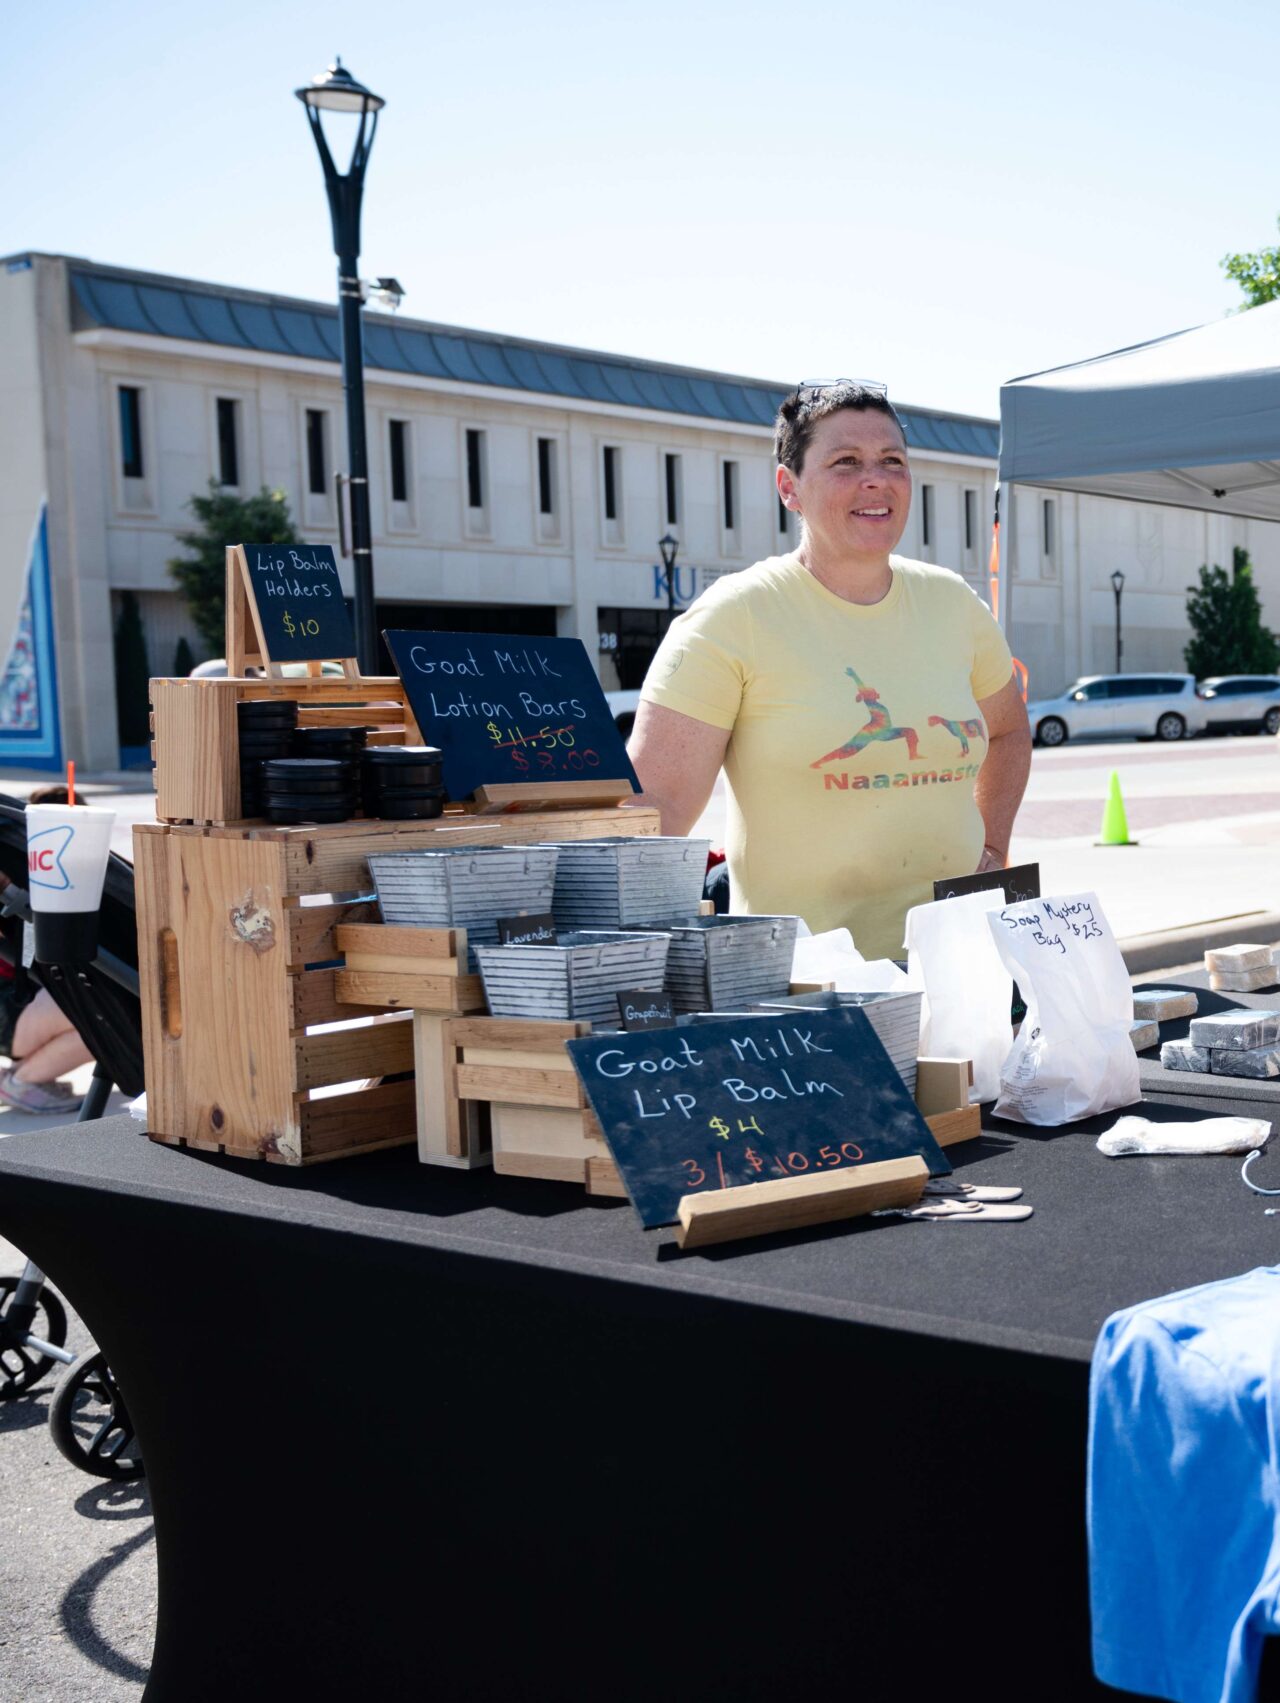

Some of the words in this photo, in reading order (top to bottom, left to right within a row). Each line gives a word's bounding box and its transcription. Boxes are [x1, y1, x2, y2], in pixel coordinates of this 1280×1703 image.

[257, 552, 285, 577] Lip
[288, 550, 336, 575] Balm
[265, 578, 332, 597] Holders
[653, 565, 697, 605] KU
[282, 610, 320, 638] $10
[410, 646, 485, 676] Goat
[494, 649, 562, 678] Milk
[430, 691, 514, 720] Lotion
[519, 691, 587, 719] Bars
[486, 721, 576, 748] $11.50
[1000, 911, 1044, 932] Soap
[1043, 902, 1094, 930] Mystery
[506, 926, 557, 945] Lavender
[1032, 931, 1066, 954] Bag
[1072, 922, 1103, 940] $25
[625, 1001, 673, 1024] Grapefruit
[596, 1038, 703, 1078] Goat
[730, 1028, 833, 1061] Milk
[634, 1089, 697, 1120] Lip
[722, 1068, 845, 1102] Balm
[708, 1115, 765, 1140] $4
